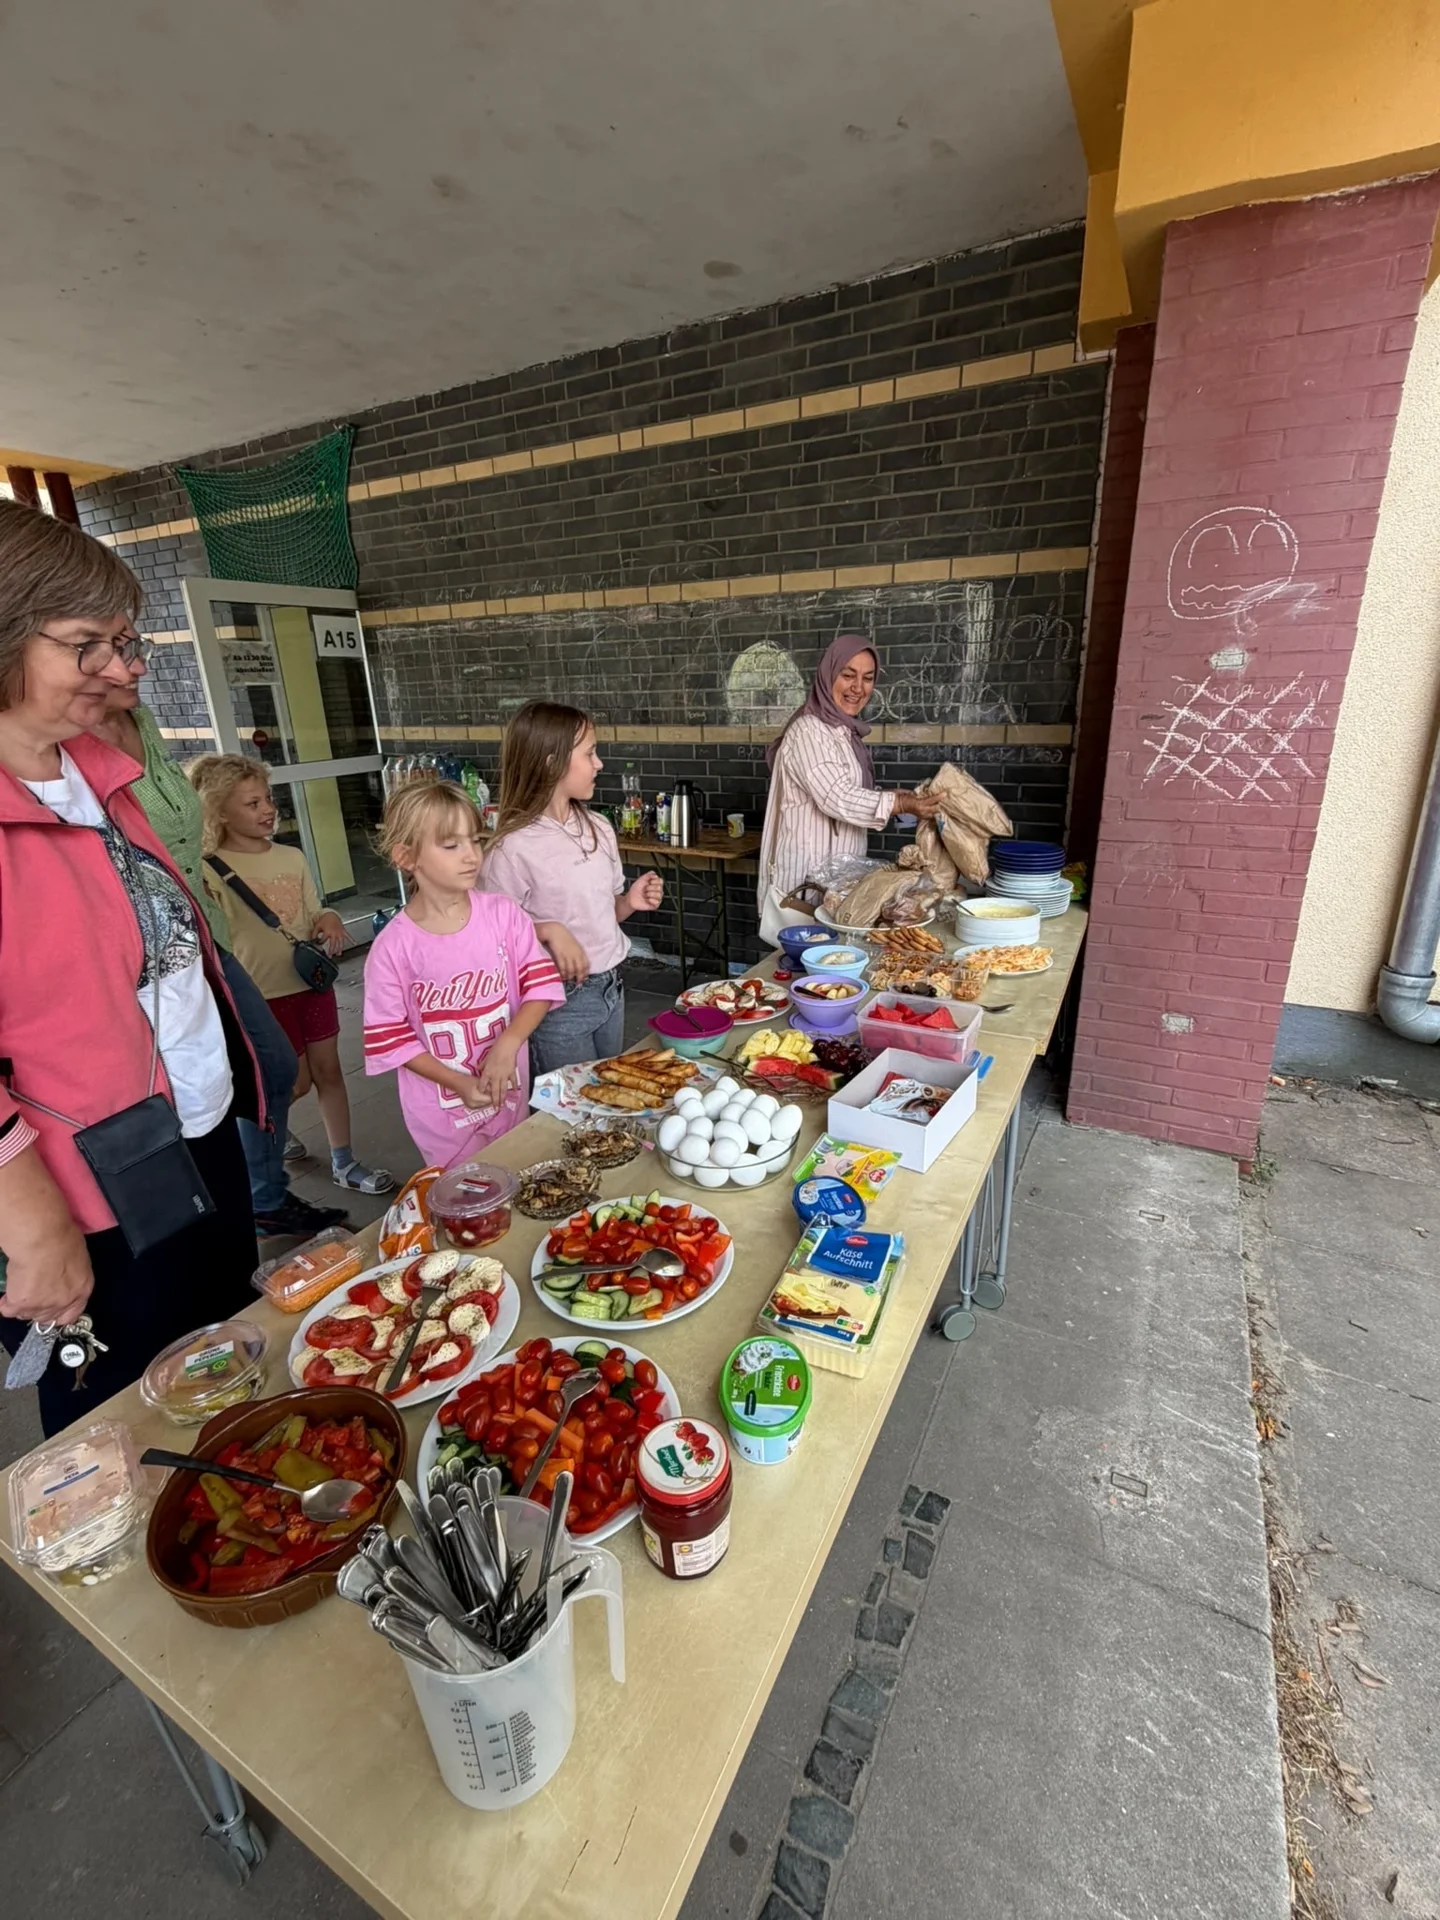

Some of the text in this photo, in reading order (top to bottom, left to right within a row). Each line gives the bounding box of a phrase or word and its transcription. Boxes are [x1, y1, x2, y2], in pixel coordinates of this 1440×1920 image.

[323, 629, 357, 650] A15
[823, 1250, 874, 1269] Aufschnitt
[840, 1247, 864, 1259] Käse
